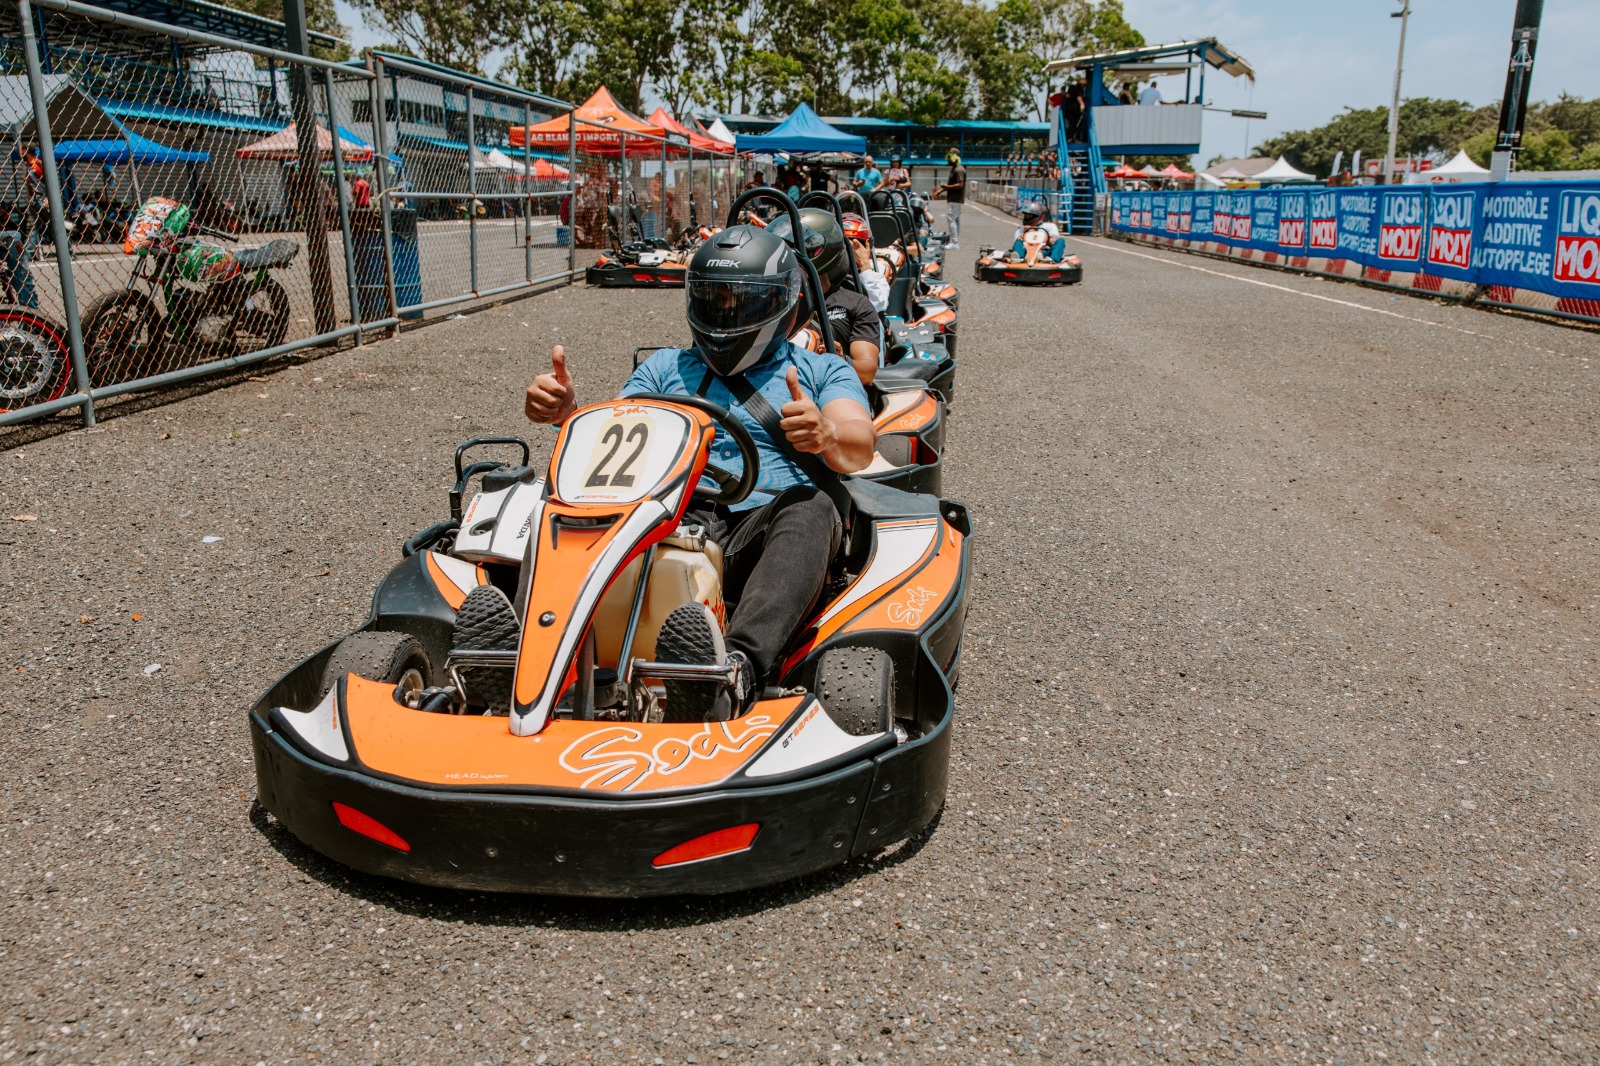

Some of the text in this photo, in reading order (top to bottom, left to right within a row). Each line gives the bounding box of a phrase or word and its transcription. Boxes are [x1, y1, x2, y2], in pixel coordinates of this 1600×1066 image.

[545, 133, 581, 142] BLANO
[1383, 196, 1421, 225] LIQUI
[1482, 190, 1549, 220] MOTORÖLE
[1311, 221, 1336, 247] MOLY
[1380, 228, 1421, 258] MOLY
[1430, 230, 1471, 265] MOLY
[1483, 222, 1542, 247] ADDITIVE
[1471, 247, 1551, 276] AUTOPFLEGE
[613, 404, 648, 417] Sodi
[585, 422, 649, 488] 22
[558, 715, 780, 791] Sodi
